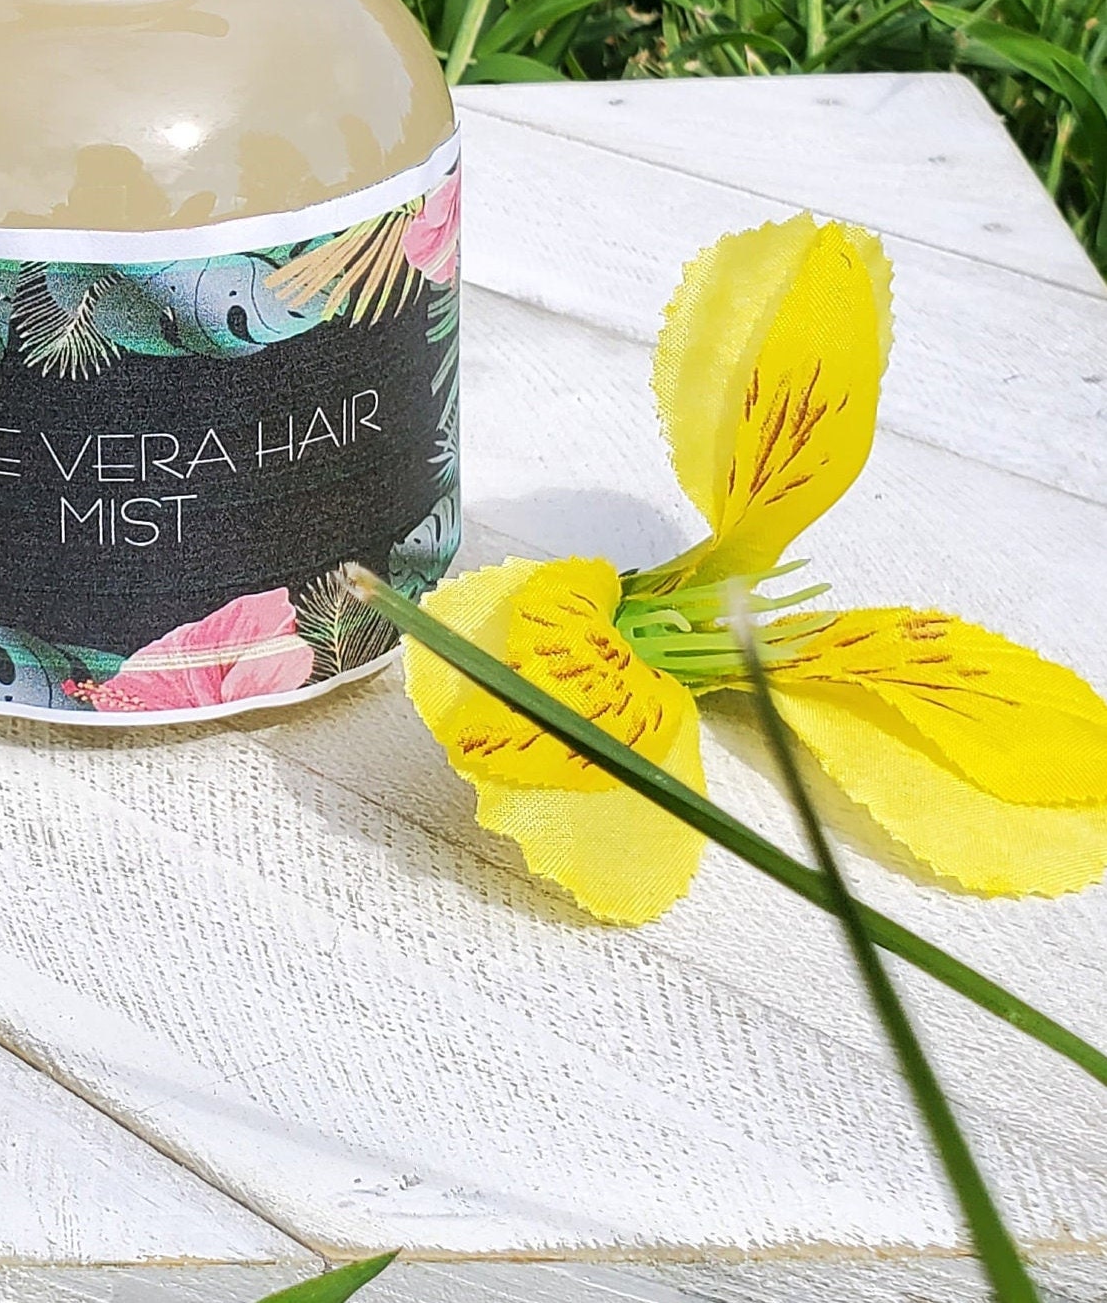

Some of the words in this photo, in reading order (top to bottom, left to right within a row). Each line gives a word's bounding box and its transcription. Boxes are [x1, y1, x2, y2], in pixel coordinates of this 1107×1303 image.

[39, 427, 237, 483] VERA
[255, 388, 383, 469] HAIR
[60, 494, 198, 547] MIST
